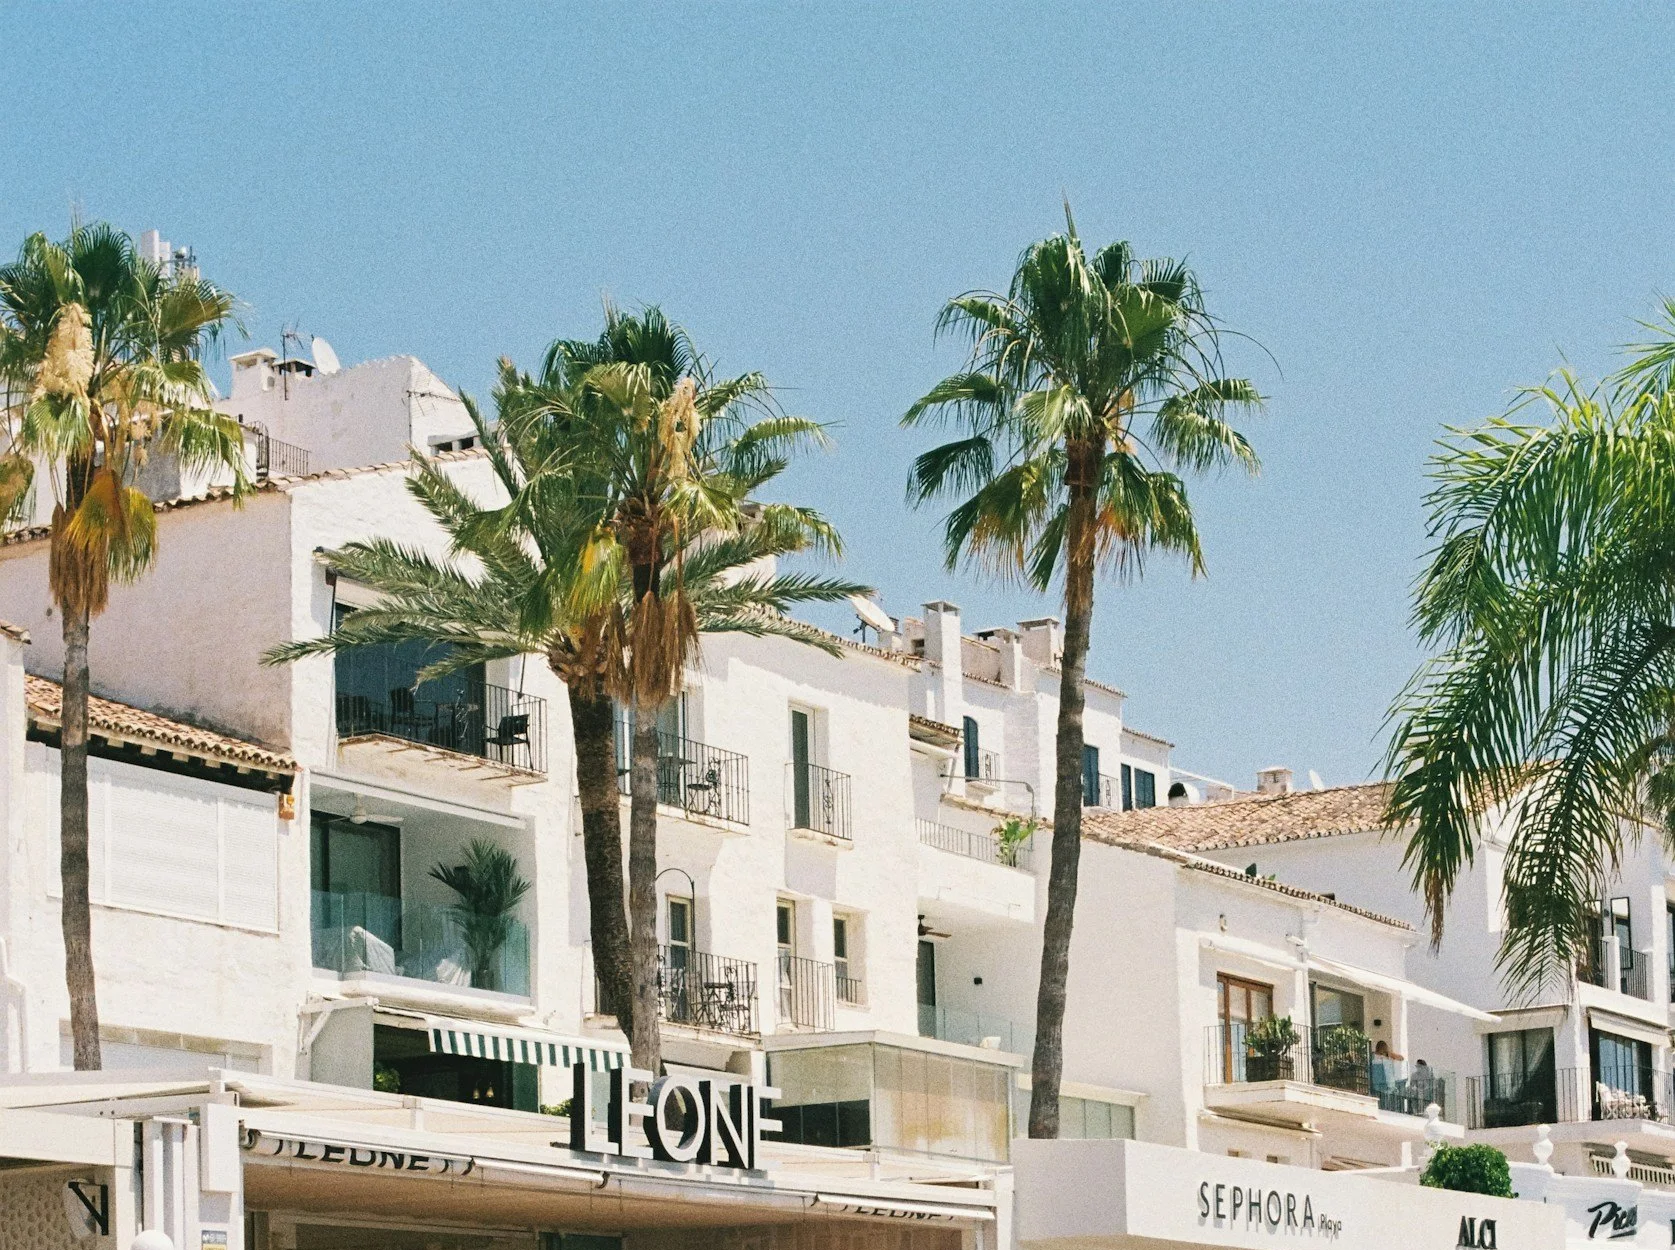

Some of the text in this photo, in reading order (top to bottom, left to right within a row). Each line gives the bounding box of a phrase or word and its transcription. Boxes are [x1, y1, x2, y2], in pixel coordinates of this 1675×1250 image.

[570, 1062, 783, 1169] LEONE
[1199, 1181, 1342, 1235] SEPHORA Playa
